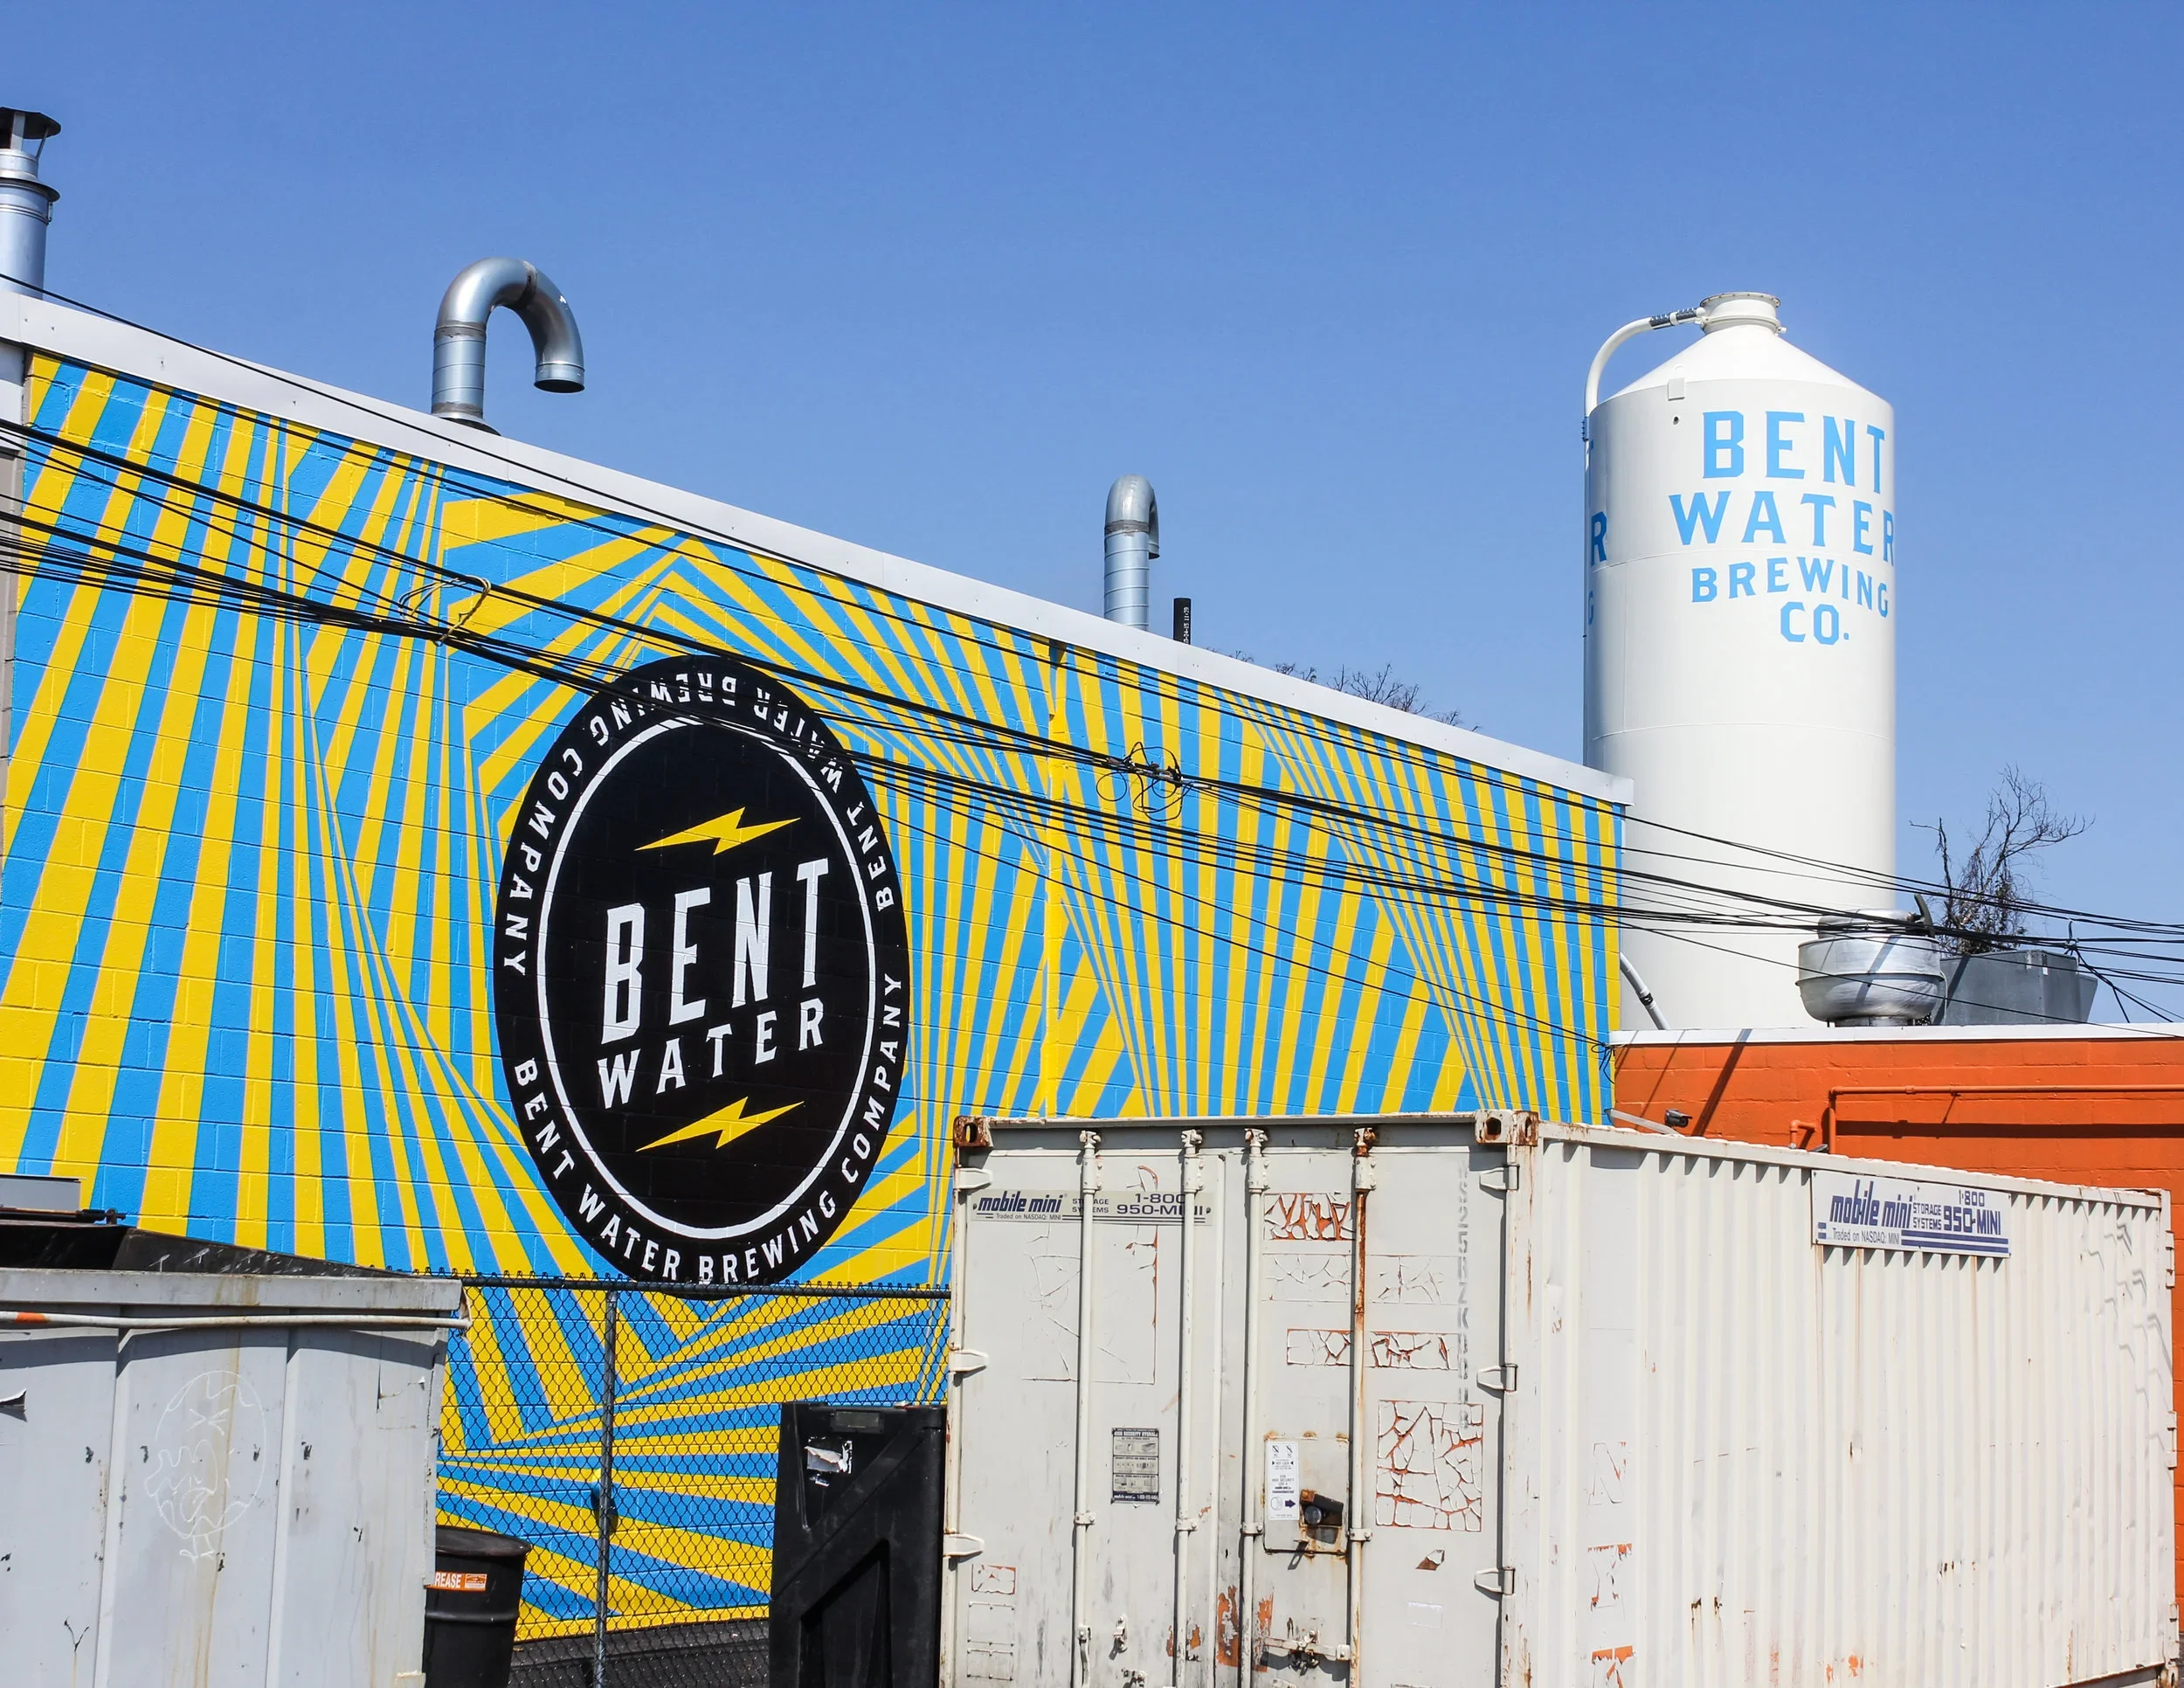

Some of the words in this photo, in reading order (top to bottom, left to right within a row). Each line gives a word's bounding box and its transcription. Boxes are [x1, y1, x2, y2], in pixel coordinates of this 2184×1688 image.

[1703, 411, 1885, 494] BENT
[1669, 490, 1894, 566] WATER
[1691, 557, 1889, 618] BREWING
[1780, 601, 1849, 645] CO.
[503, 747, 584, 976] COMPANY
[847, 801, 895, 913] BENT
[600, 857, 829, 1045] BENT
[597, 998, 824, 1110] WATER
[514, 1057, 576, 1180] BENT
[577, 1183, 681, 1281] WATER
[699, 1190, 837, 1285] BREWING
[841, 973, 902, 1184] COMPANY
[978, 1190, 1027, 1212] mobile
[1028, 1194, 1063, 1213] mini
[1116, 1204, 1203, 1215] 950-MII
[1136, 1193, 1185, 1204] 1-800
[1829, 1180, 1880, 1226] mobile
[1881, 1194, 1913, 1228] mini
[1912, 1202, 1942, 1216] STORAGE
[1833, 1228, 1851, 1242] Traded
[1853, 1233, 1860, 1242] on
[1888, 1233, 1900, 1245] MINI
[1912, 1216, 1942, 1230] SYSTEMS
[434, 1573, 461, 1588] REASE
